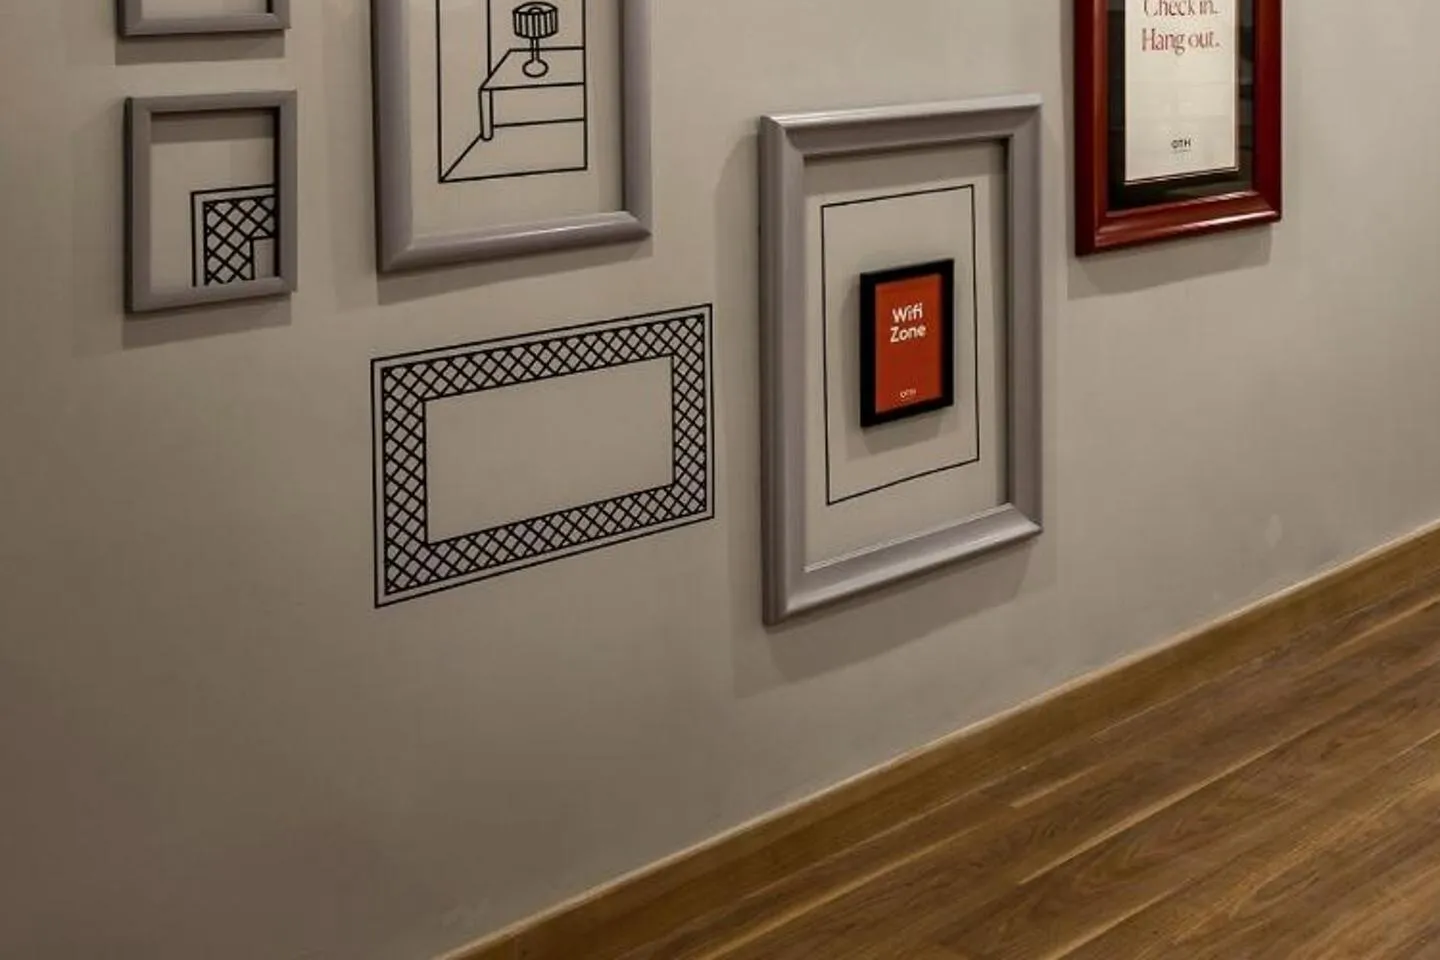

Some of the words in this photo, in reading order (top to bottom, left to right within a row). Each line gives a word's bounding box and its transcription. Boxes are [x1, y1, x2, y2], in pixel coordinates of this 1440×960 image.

[1141, 28, 1186, 56] Hang
[1188, 30, 1220, 49] out.
[892, 302, 923, 323] Wifi
[890, 325, 926, 343] Zone
